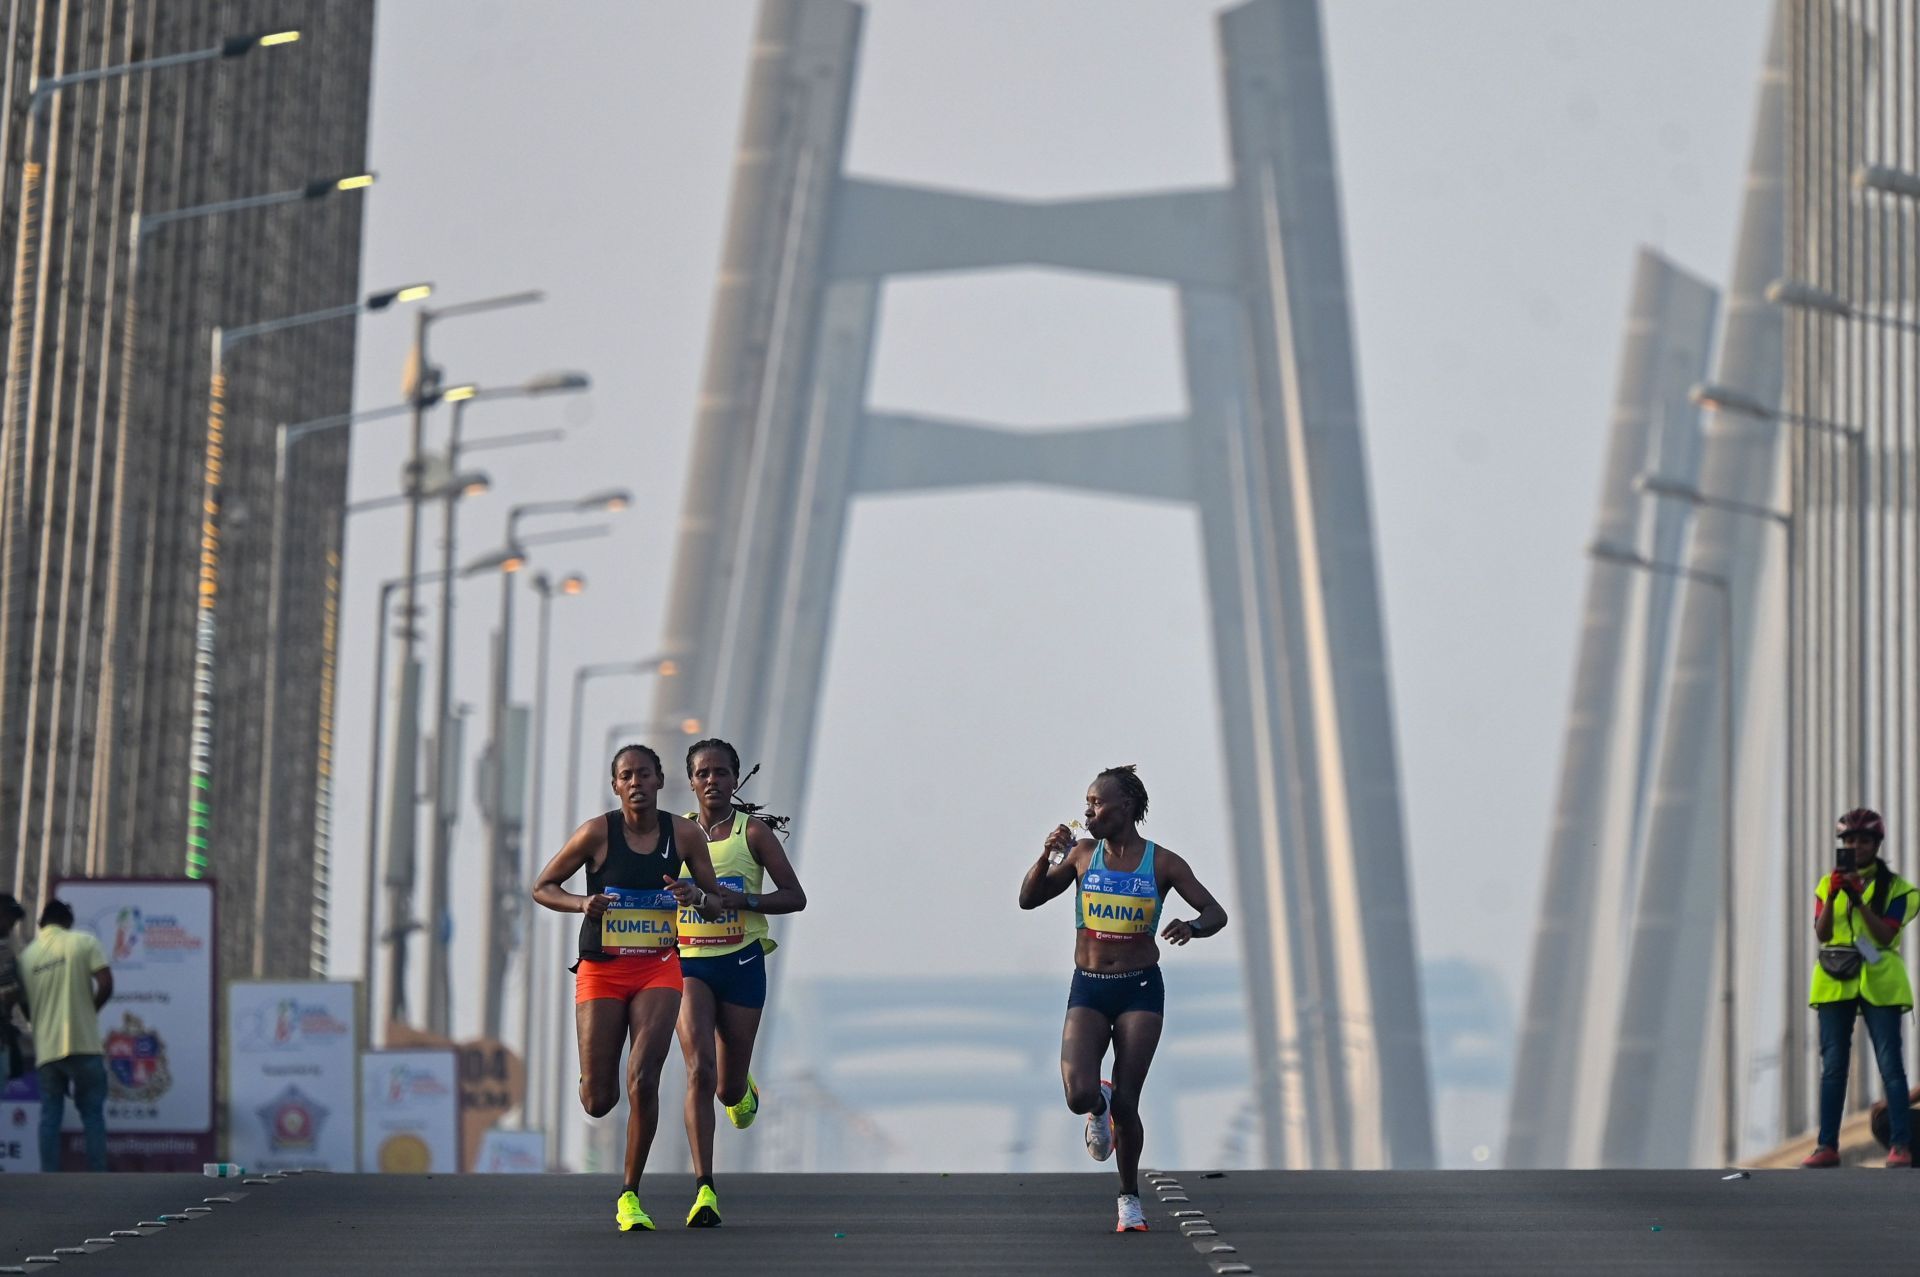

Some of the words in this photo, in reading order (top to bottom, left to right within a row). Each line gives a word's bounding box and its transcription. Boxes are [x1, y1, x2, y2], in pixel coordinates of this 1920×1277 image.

[680, 909, 738, 924] ZINSH
[1089, 903, 1144, 921] MAINA
[606, 920, 672, 933] KUMELA
[727, 926, 741, 934] 111
[658, 937, 674, 945] 109
